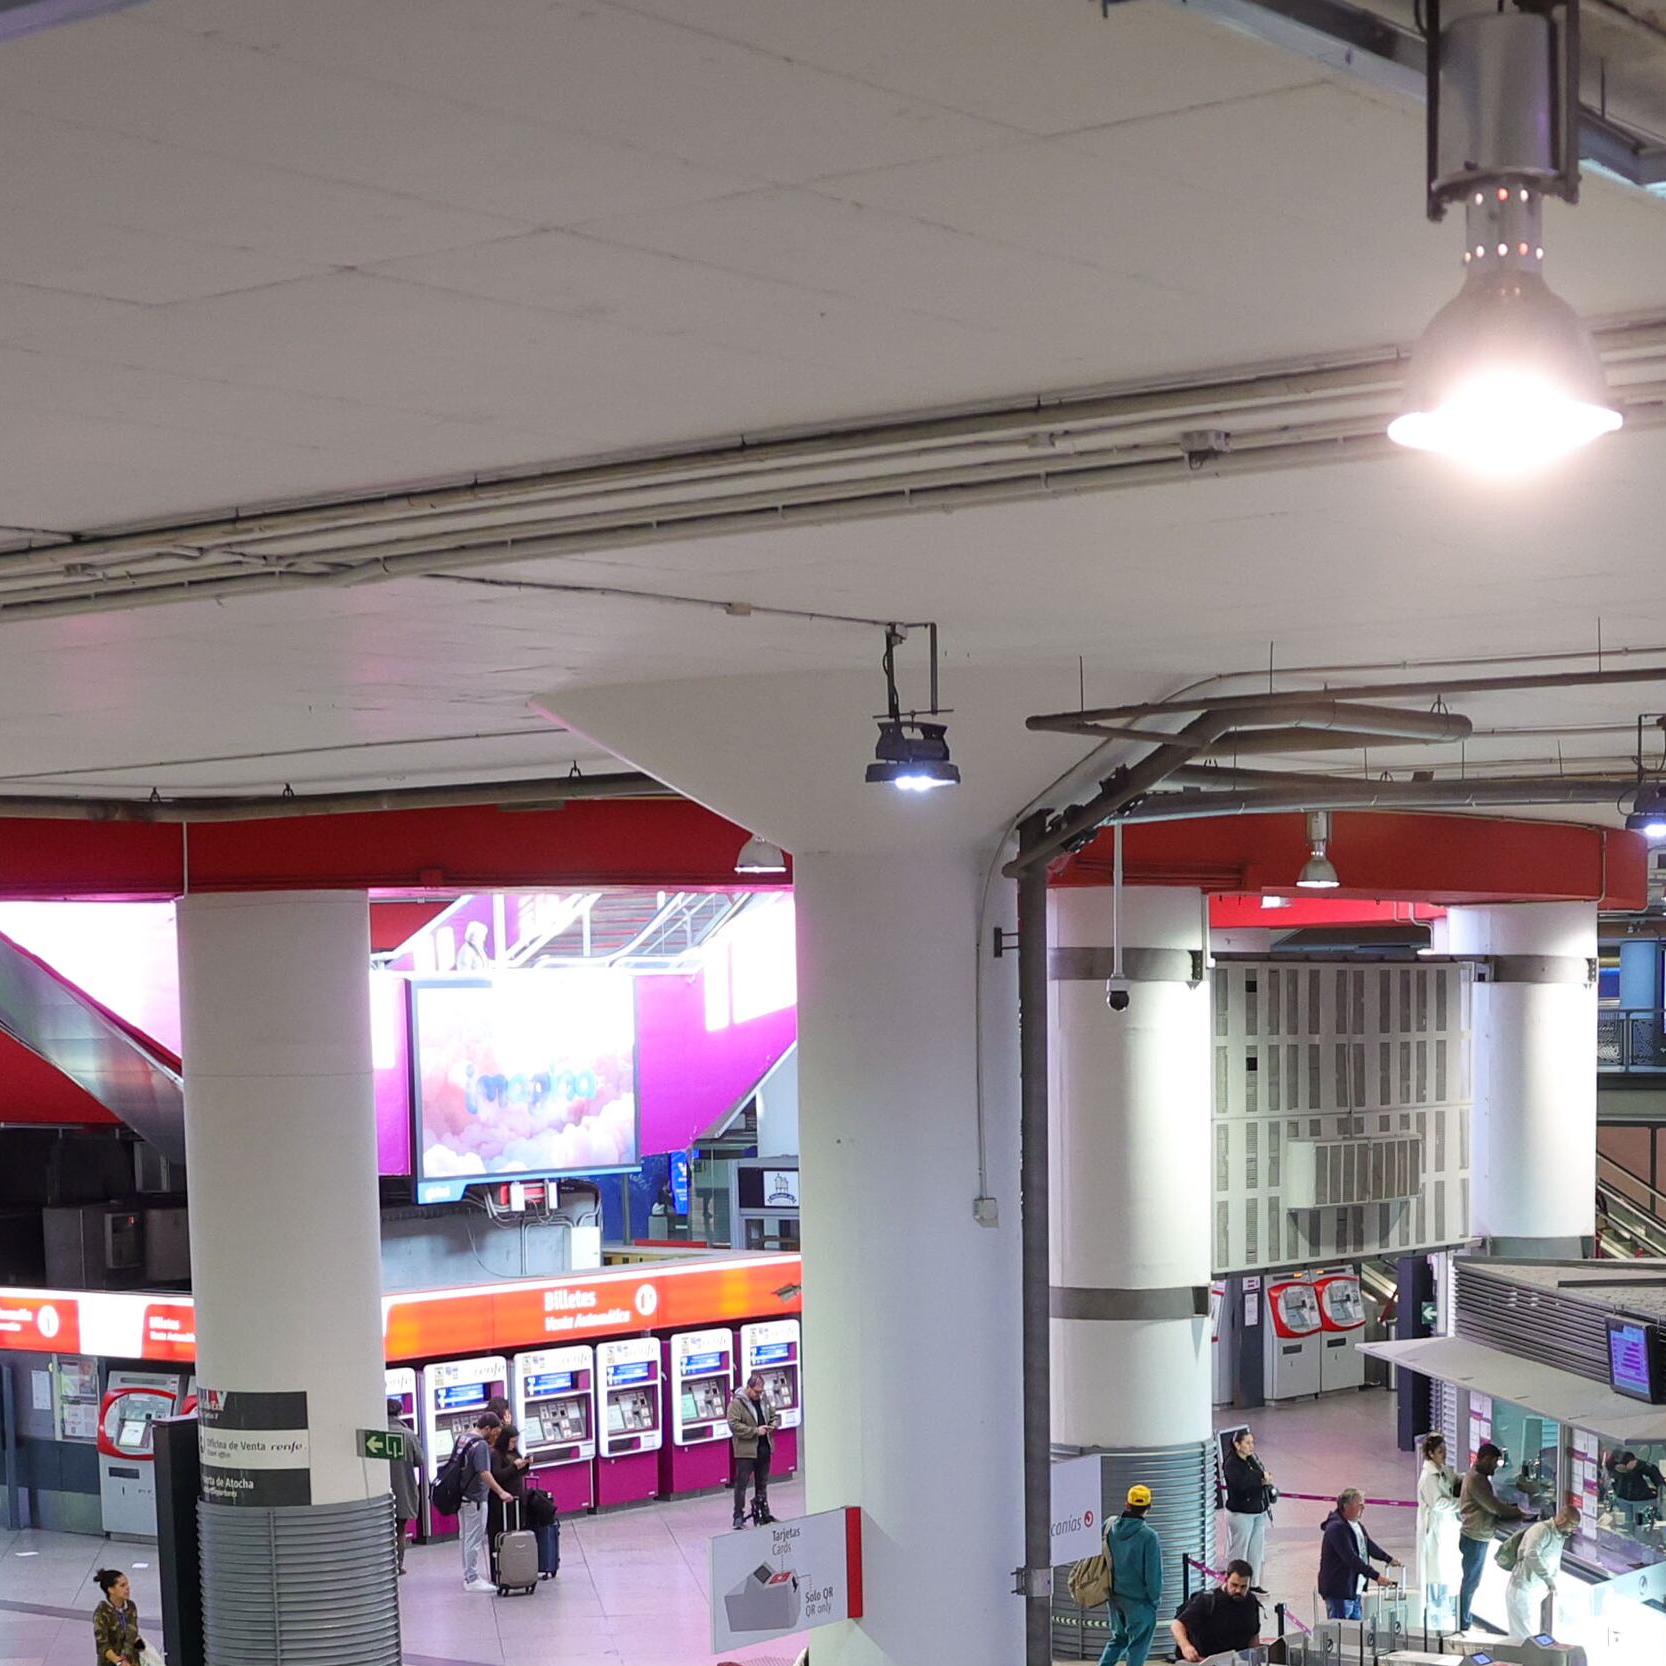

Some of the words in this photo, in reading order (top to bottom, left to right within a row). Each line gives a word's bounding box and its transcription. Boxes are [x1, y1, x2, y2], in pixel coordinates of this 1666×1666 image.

[544, 1288, 597, 1312] Billetes
[229, 1440, 239, 1451] de
[240, 1441, 266, 1451] Venta
[270, 1441, 303, 1454] renfe
[216, 1476, 224, 1487] de
[225, 1478, 254, 1489] Atocha
[1050, 1514, 1082, 1537] canías
[772, 1528, 801, 1543] Tarjetas
[772, 1543, 792, 1556] Cards
[805, 1590, 822, 1604] Solo
[822, 1586, 834, 1600] QR
[805, 1605, 816, 1618] QR
[817, 1602, 832, 1615] only
